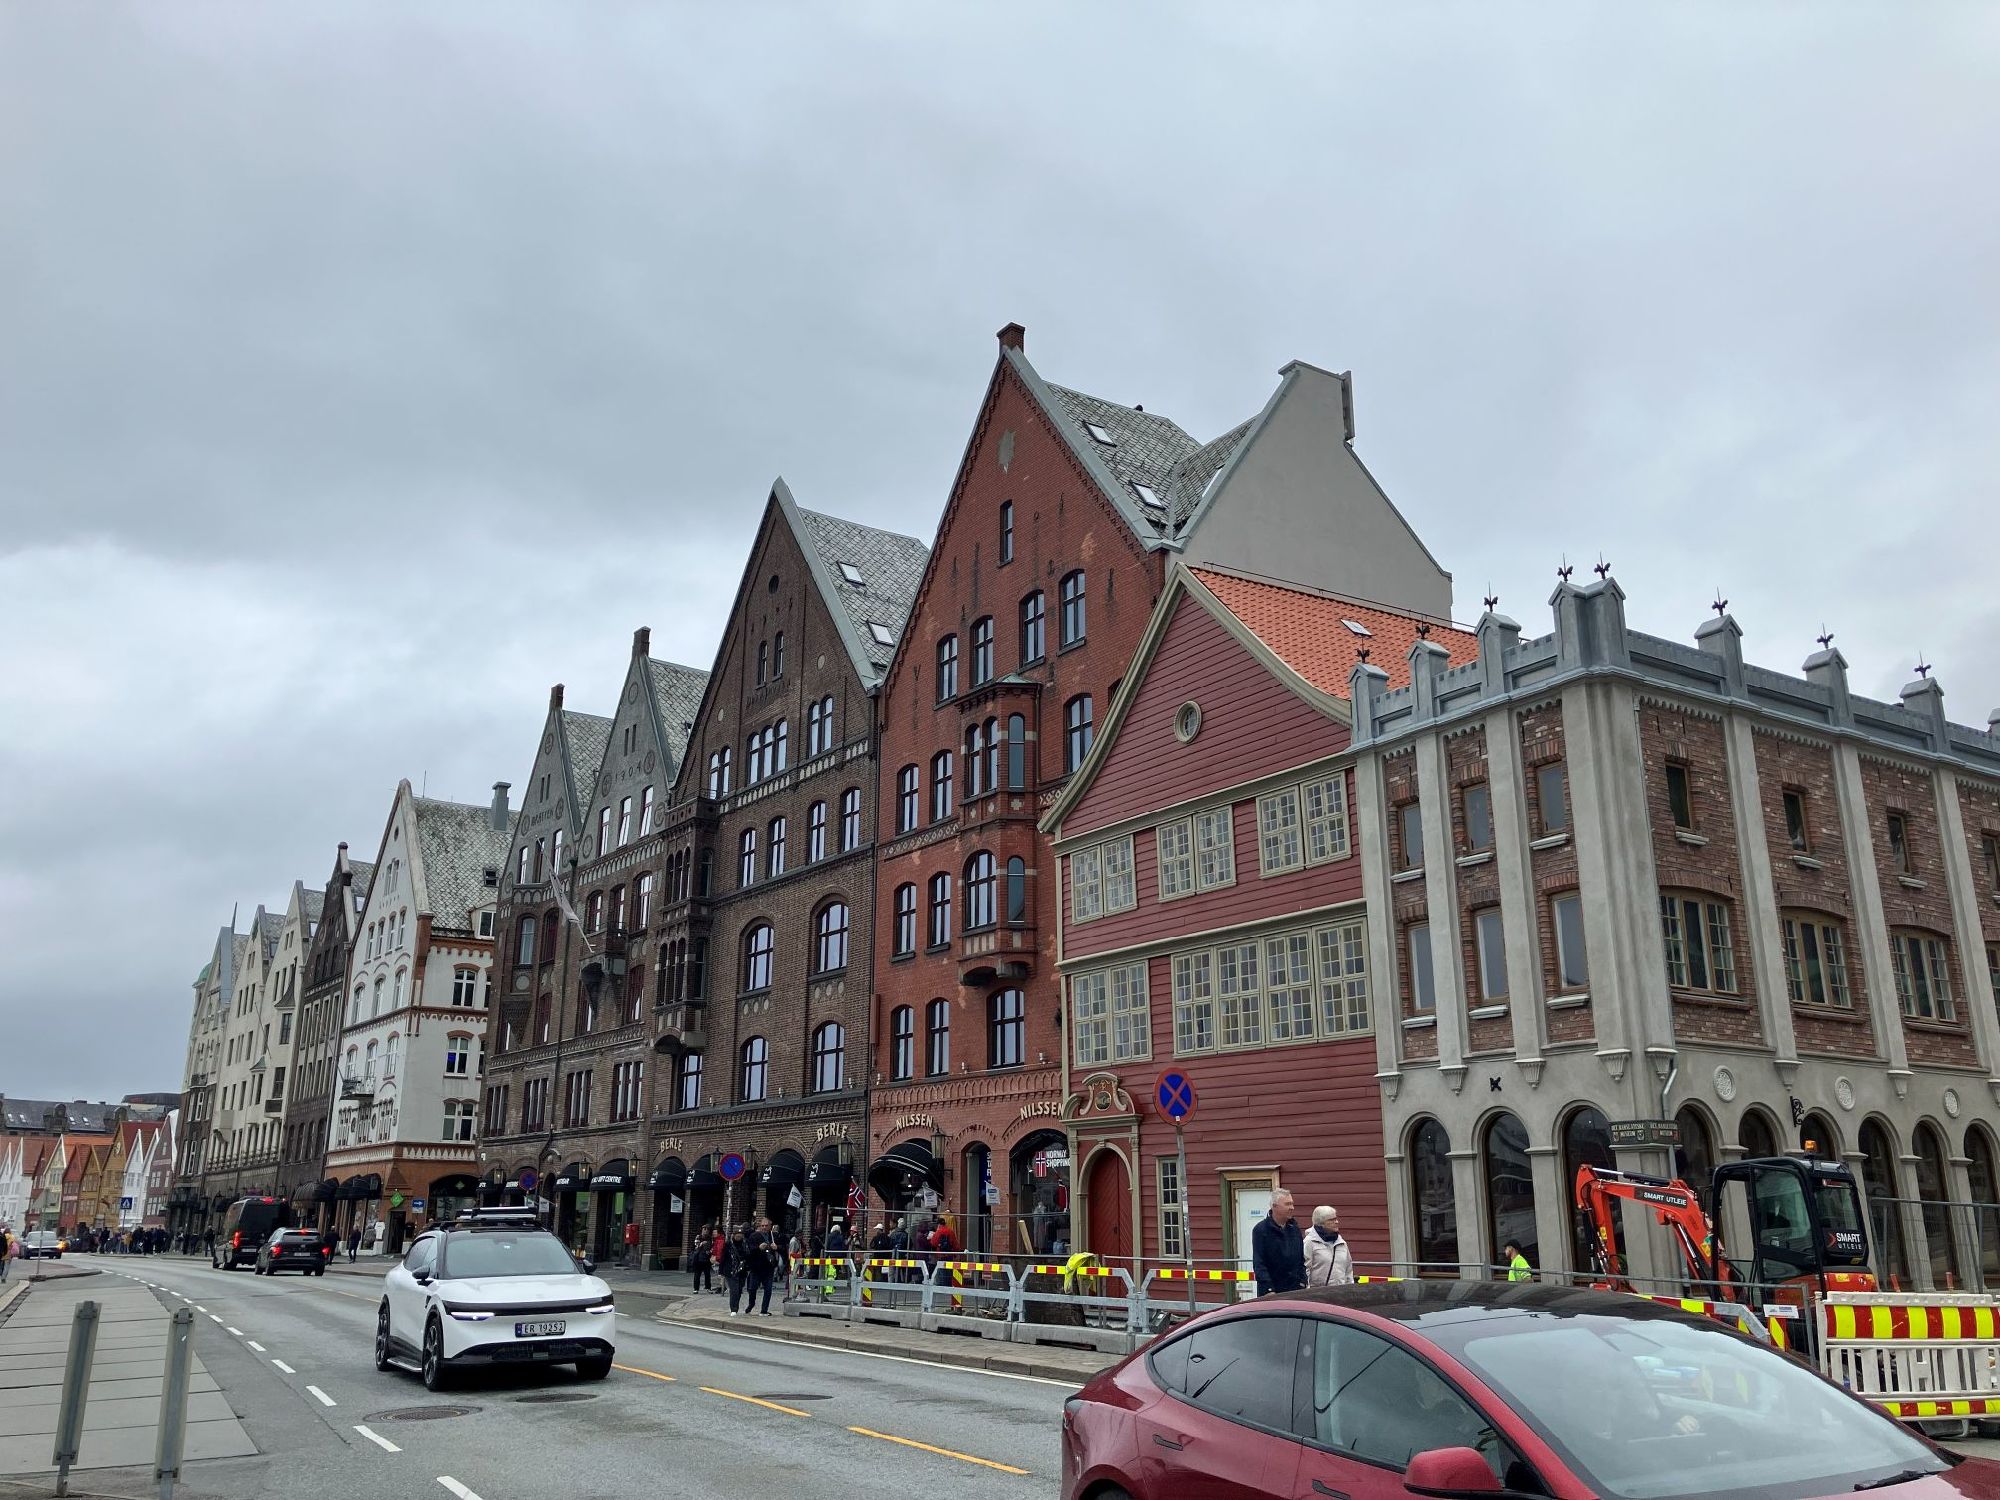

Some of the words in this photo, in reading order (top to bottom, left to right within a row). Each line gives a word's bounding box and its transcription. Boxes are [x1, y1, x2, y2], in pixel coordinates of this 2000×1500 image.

[1020, 1101, 1064, 1120] NILSSEN
[896, 1113, 934, 1131] NILSSEN
[817, 1122, 848, 1142] BERLE
[660, 1137, 683, 1153] BERLE
[1643, 1191, 1664, 1201] SMART
[1666, 1195, 1687, 1206] UTLEIE
[1835, 1232, 1860, 1243] SMART
